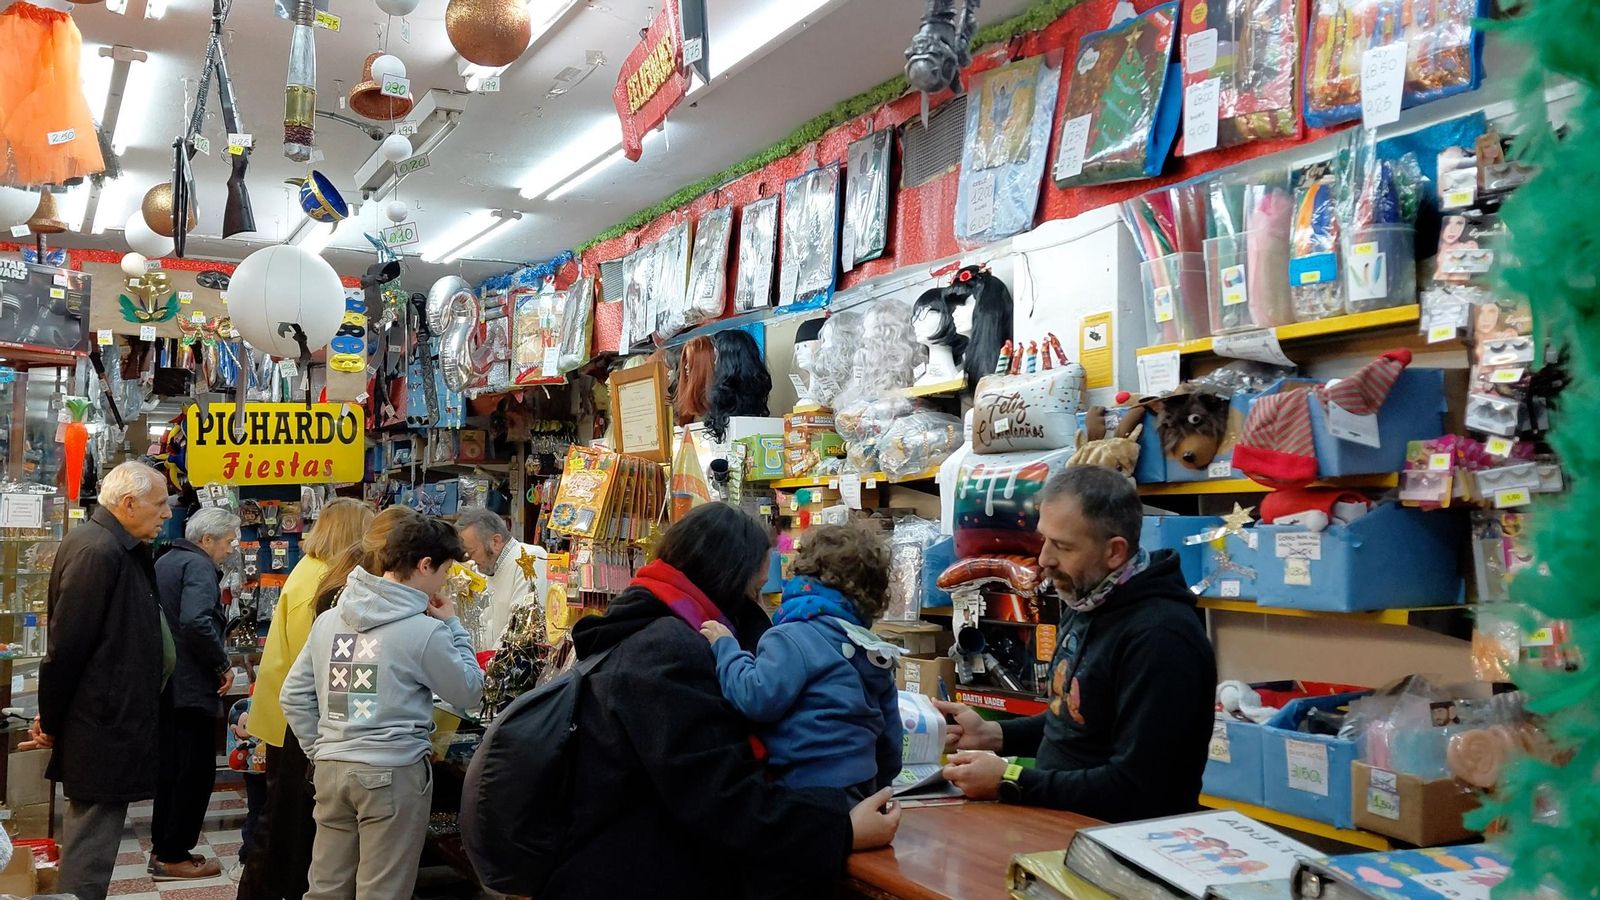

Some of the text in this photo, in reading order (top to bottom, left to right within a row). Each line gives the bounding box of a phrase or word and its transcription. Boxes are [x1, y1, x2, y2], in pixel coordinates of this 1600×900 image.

[0, 260, 25, 271] TAR
[982, 391, 1031, 424] Feliz
[195, 411, 358, 445] PICHARDO
[223, 451, 334, 480] Fiestas
[963, 692, 1006, 707] DARTH VADER
